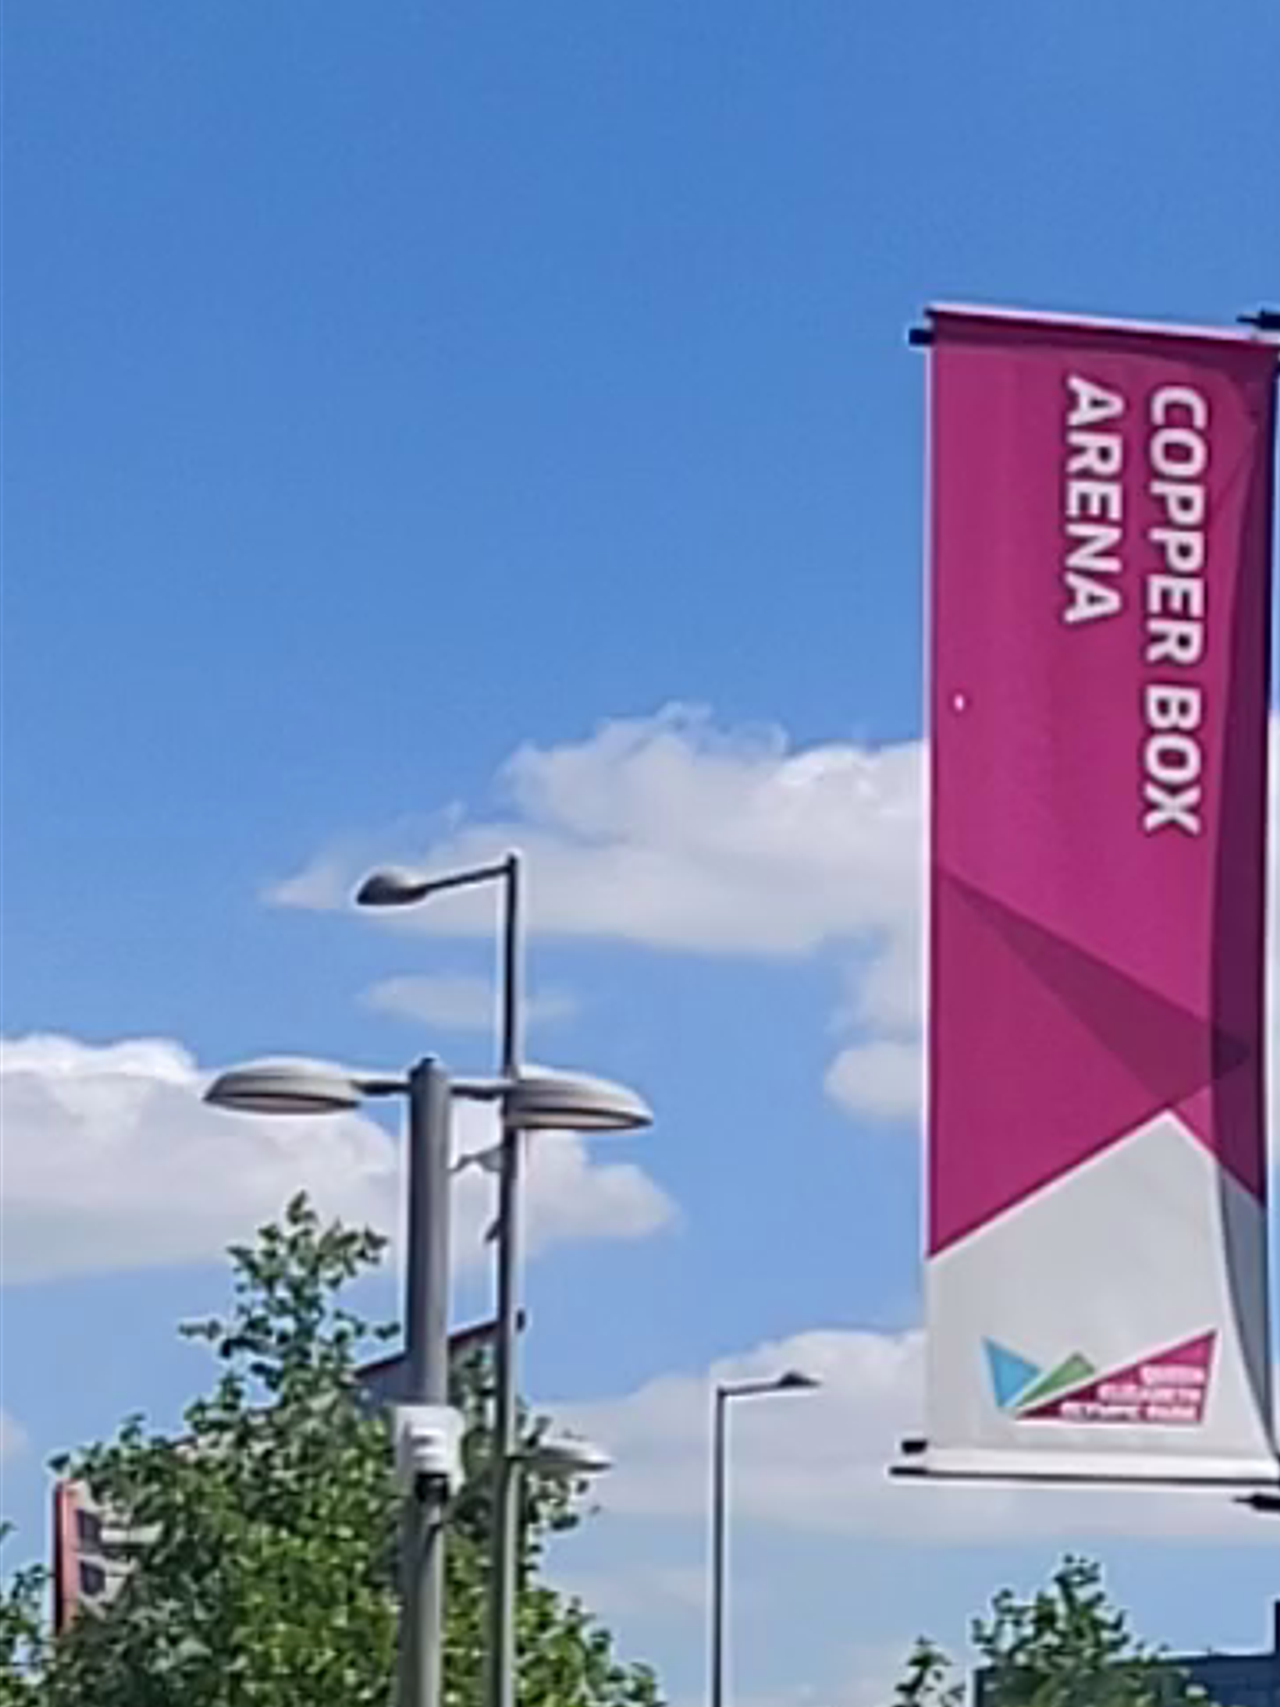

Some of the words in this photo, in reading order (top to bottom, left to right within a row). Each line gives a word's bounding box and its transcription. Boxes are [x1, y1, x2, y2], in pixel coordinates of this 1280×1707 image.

[1065, 377, 1123, 622] ARENA
[1148, 388, 1205, 662] COPPER
[1146, 686, 1201, 833] BOX
